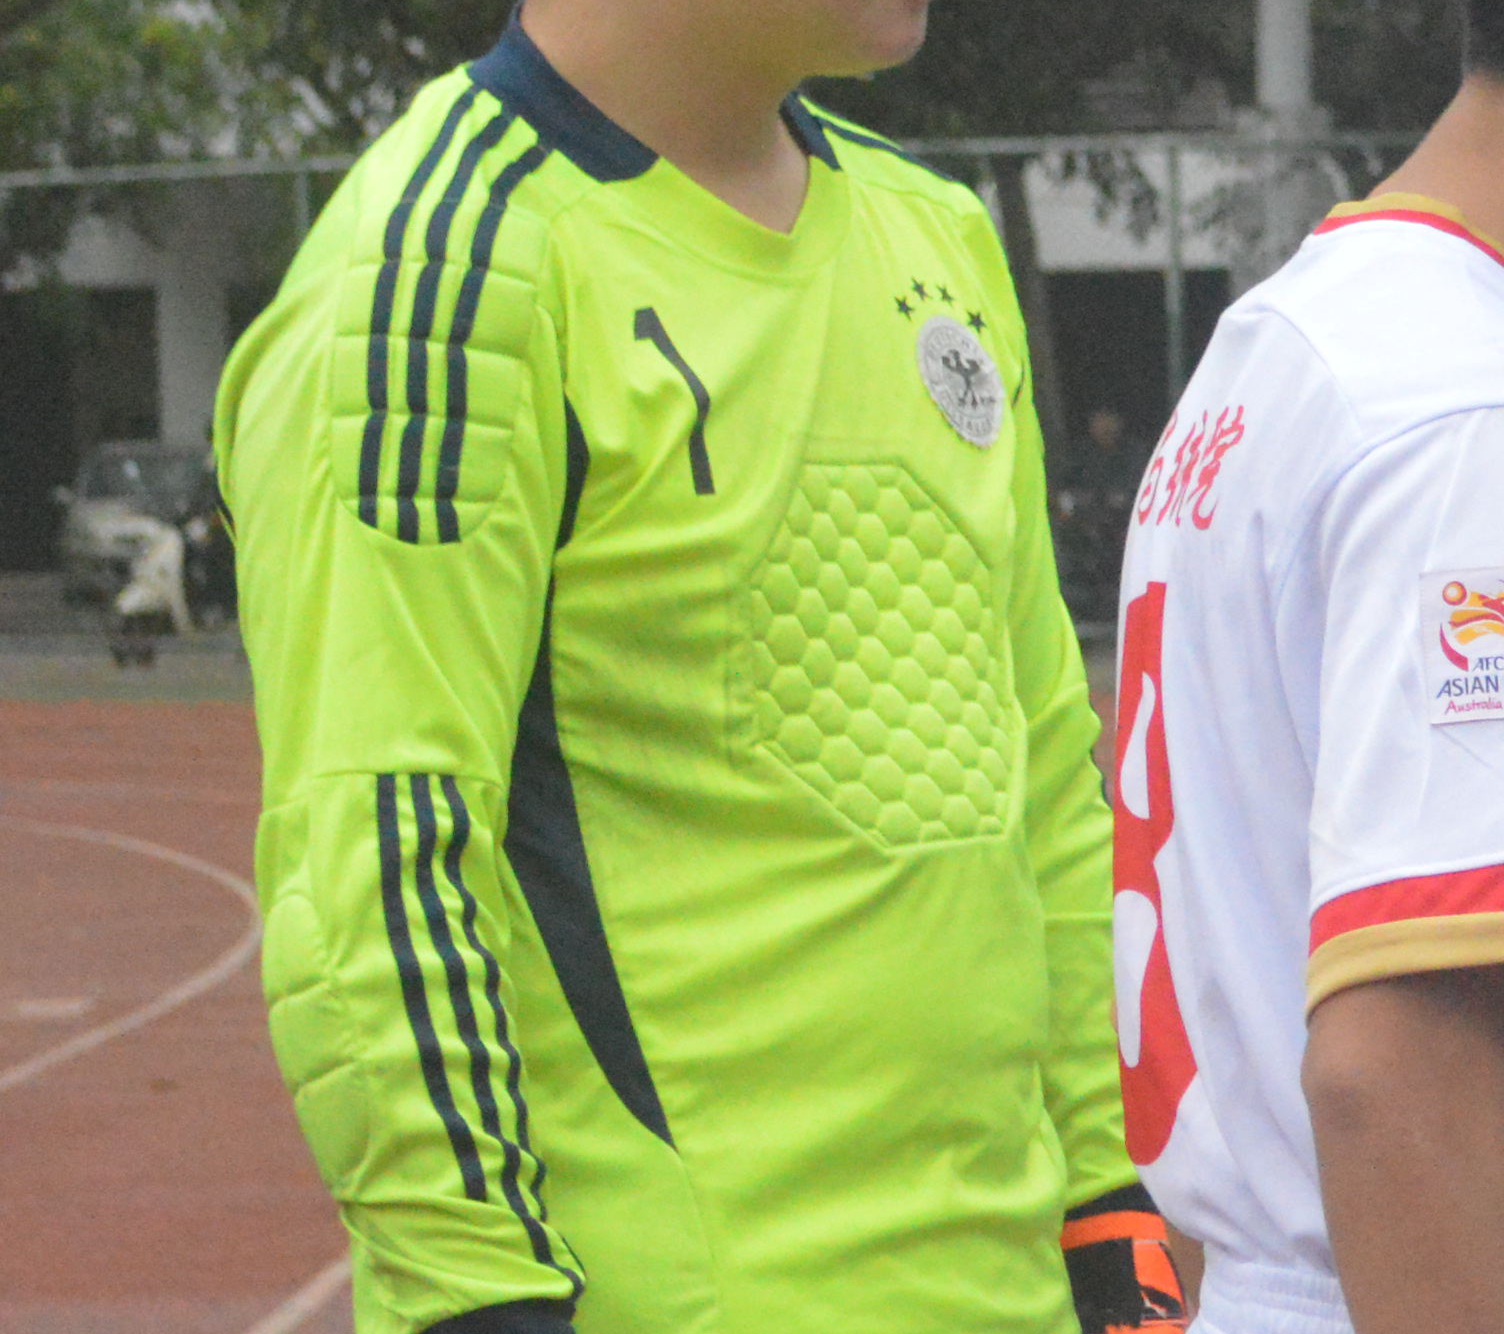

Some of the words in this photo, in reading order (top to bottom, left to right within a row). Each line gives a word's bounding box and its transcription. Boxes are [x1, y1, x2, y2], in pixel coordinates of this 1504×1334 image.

[633, 307, 714, 496] 1
[1436, 674, 1500, 699] ASIAN
[1445, 697, 1503, 715] Australia
